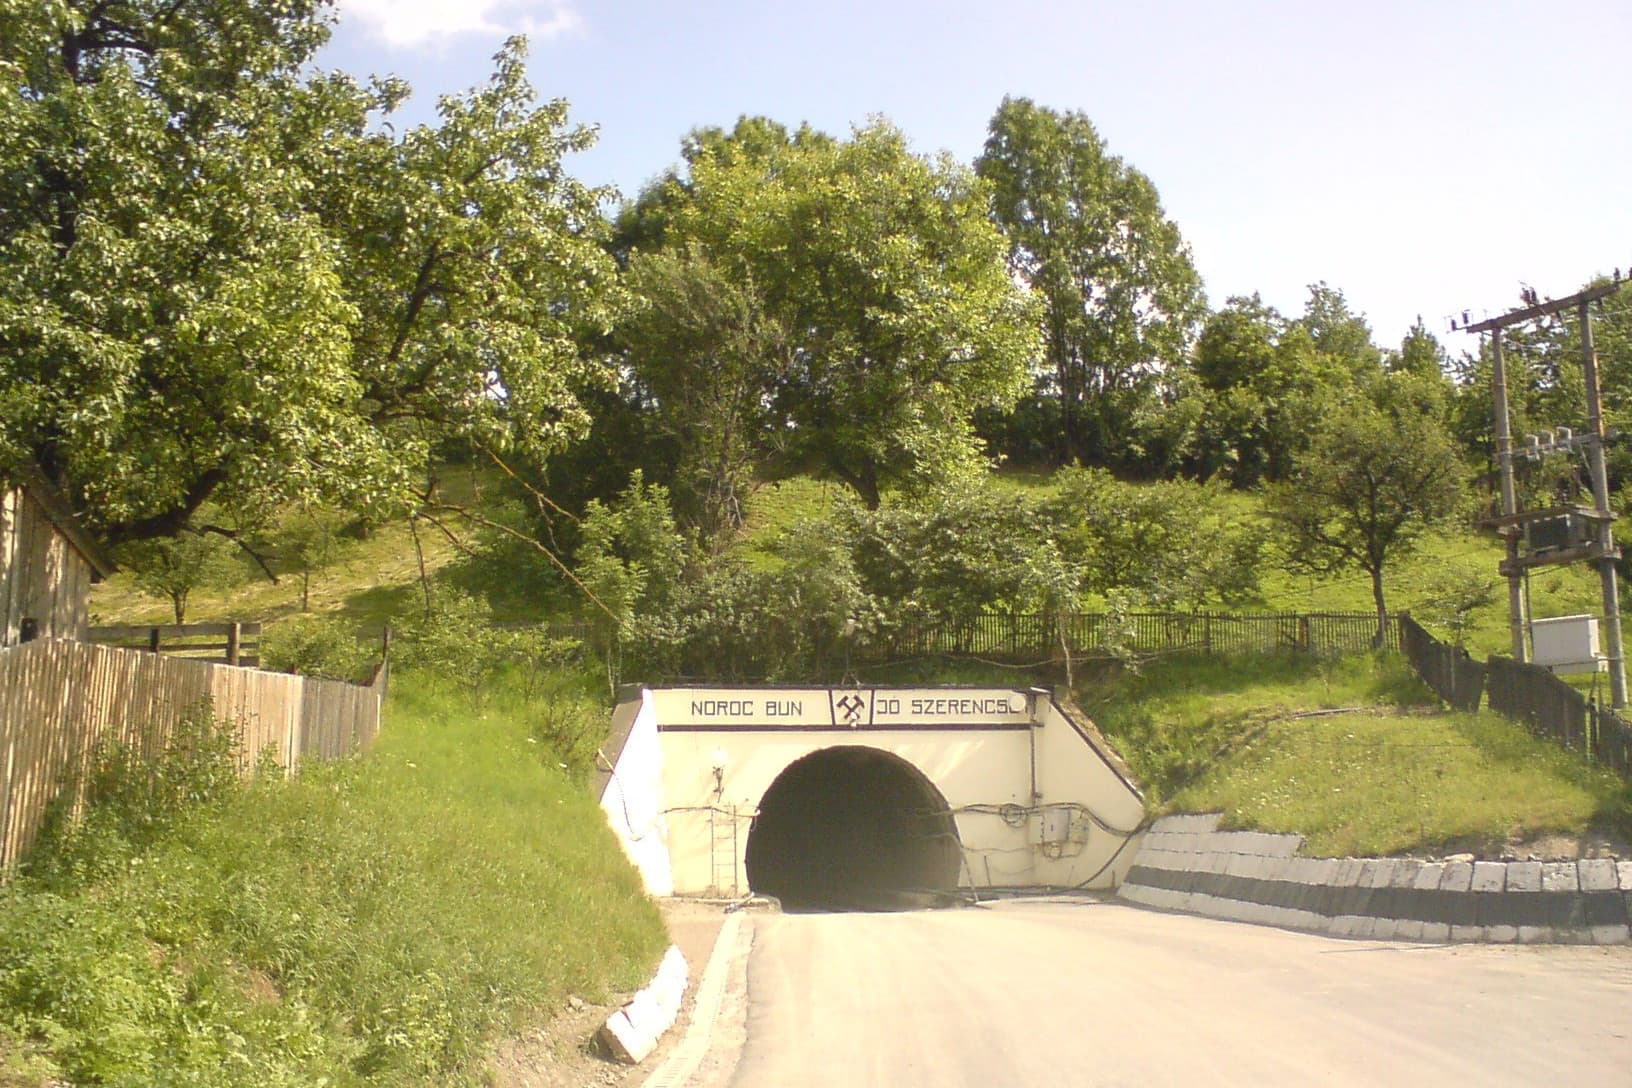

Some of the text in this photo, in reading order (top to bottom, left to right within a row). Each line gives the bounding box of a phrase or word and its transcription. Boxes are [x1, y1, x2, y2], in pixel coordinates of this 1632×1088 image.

[691, 700, 803, 716] NOROC BUN
[911, 698, 1029, 715] SZERENCS
